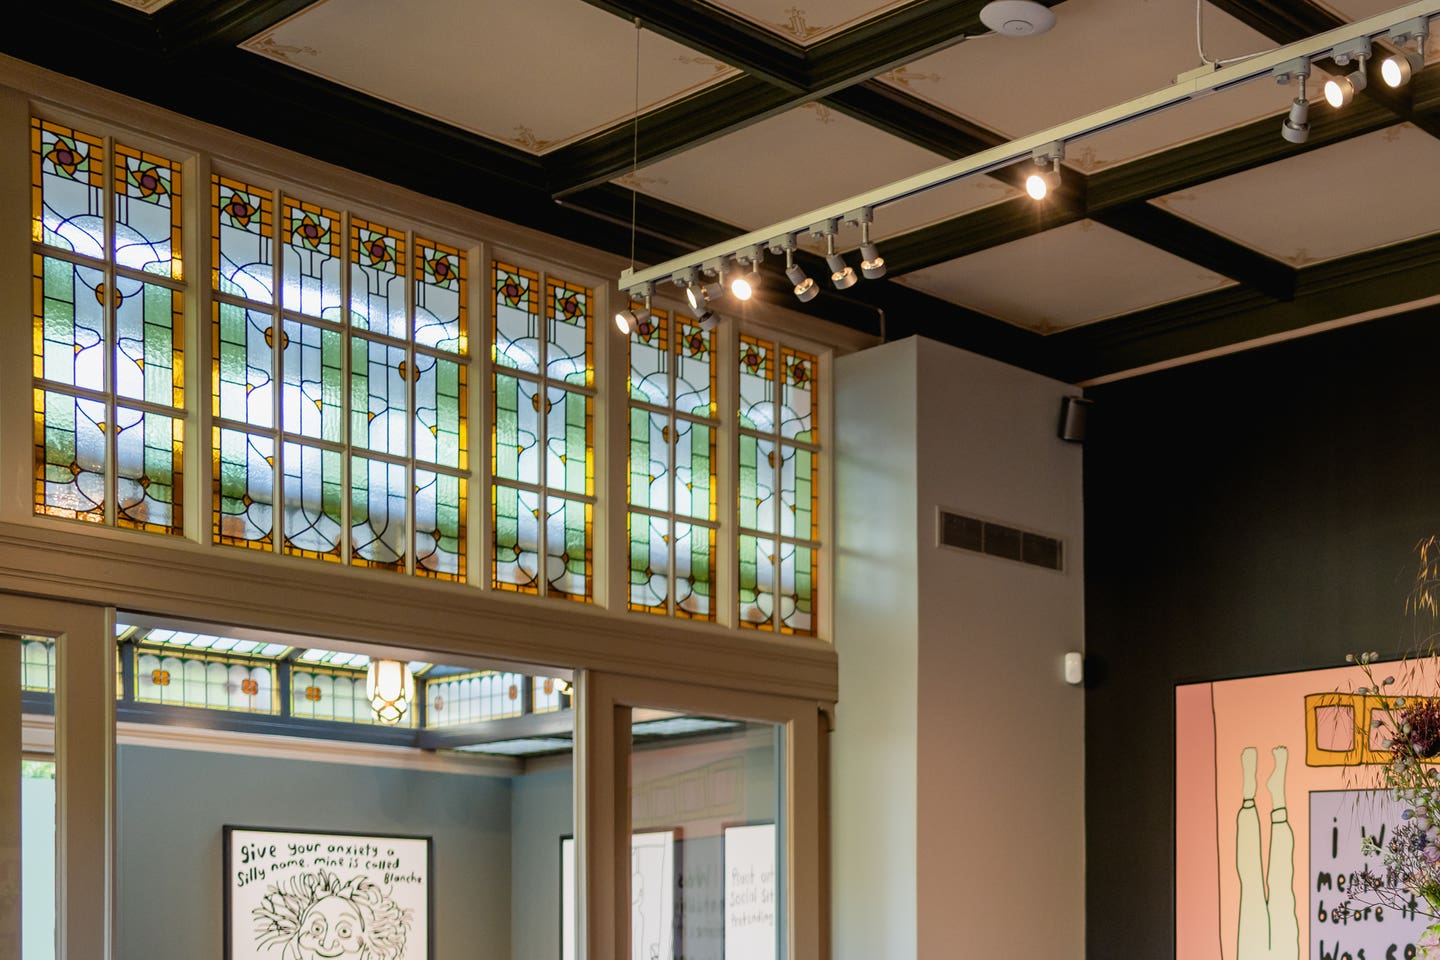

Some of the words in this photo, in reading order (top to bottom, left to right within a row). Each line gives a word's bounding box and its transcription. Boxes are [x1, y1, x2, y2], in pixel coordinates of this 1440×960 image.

[1332, 817, 1338, 859] i
[241, 843, 277, 864] give
[287, 843, 321, 856] your
[327, 844, 379, 857] anxiety
[387, 849, 395, 857] a
[237, 868, 266, 887] Silly
[314, 857, 344, 867] mine
[350, 857, 359, 869] is
[365, 858, 400, 869] called
[383, 871, 422, 885] Blanche
[1318, 900, 1384, 926] before
